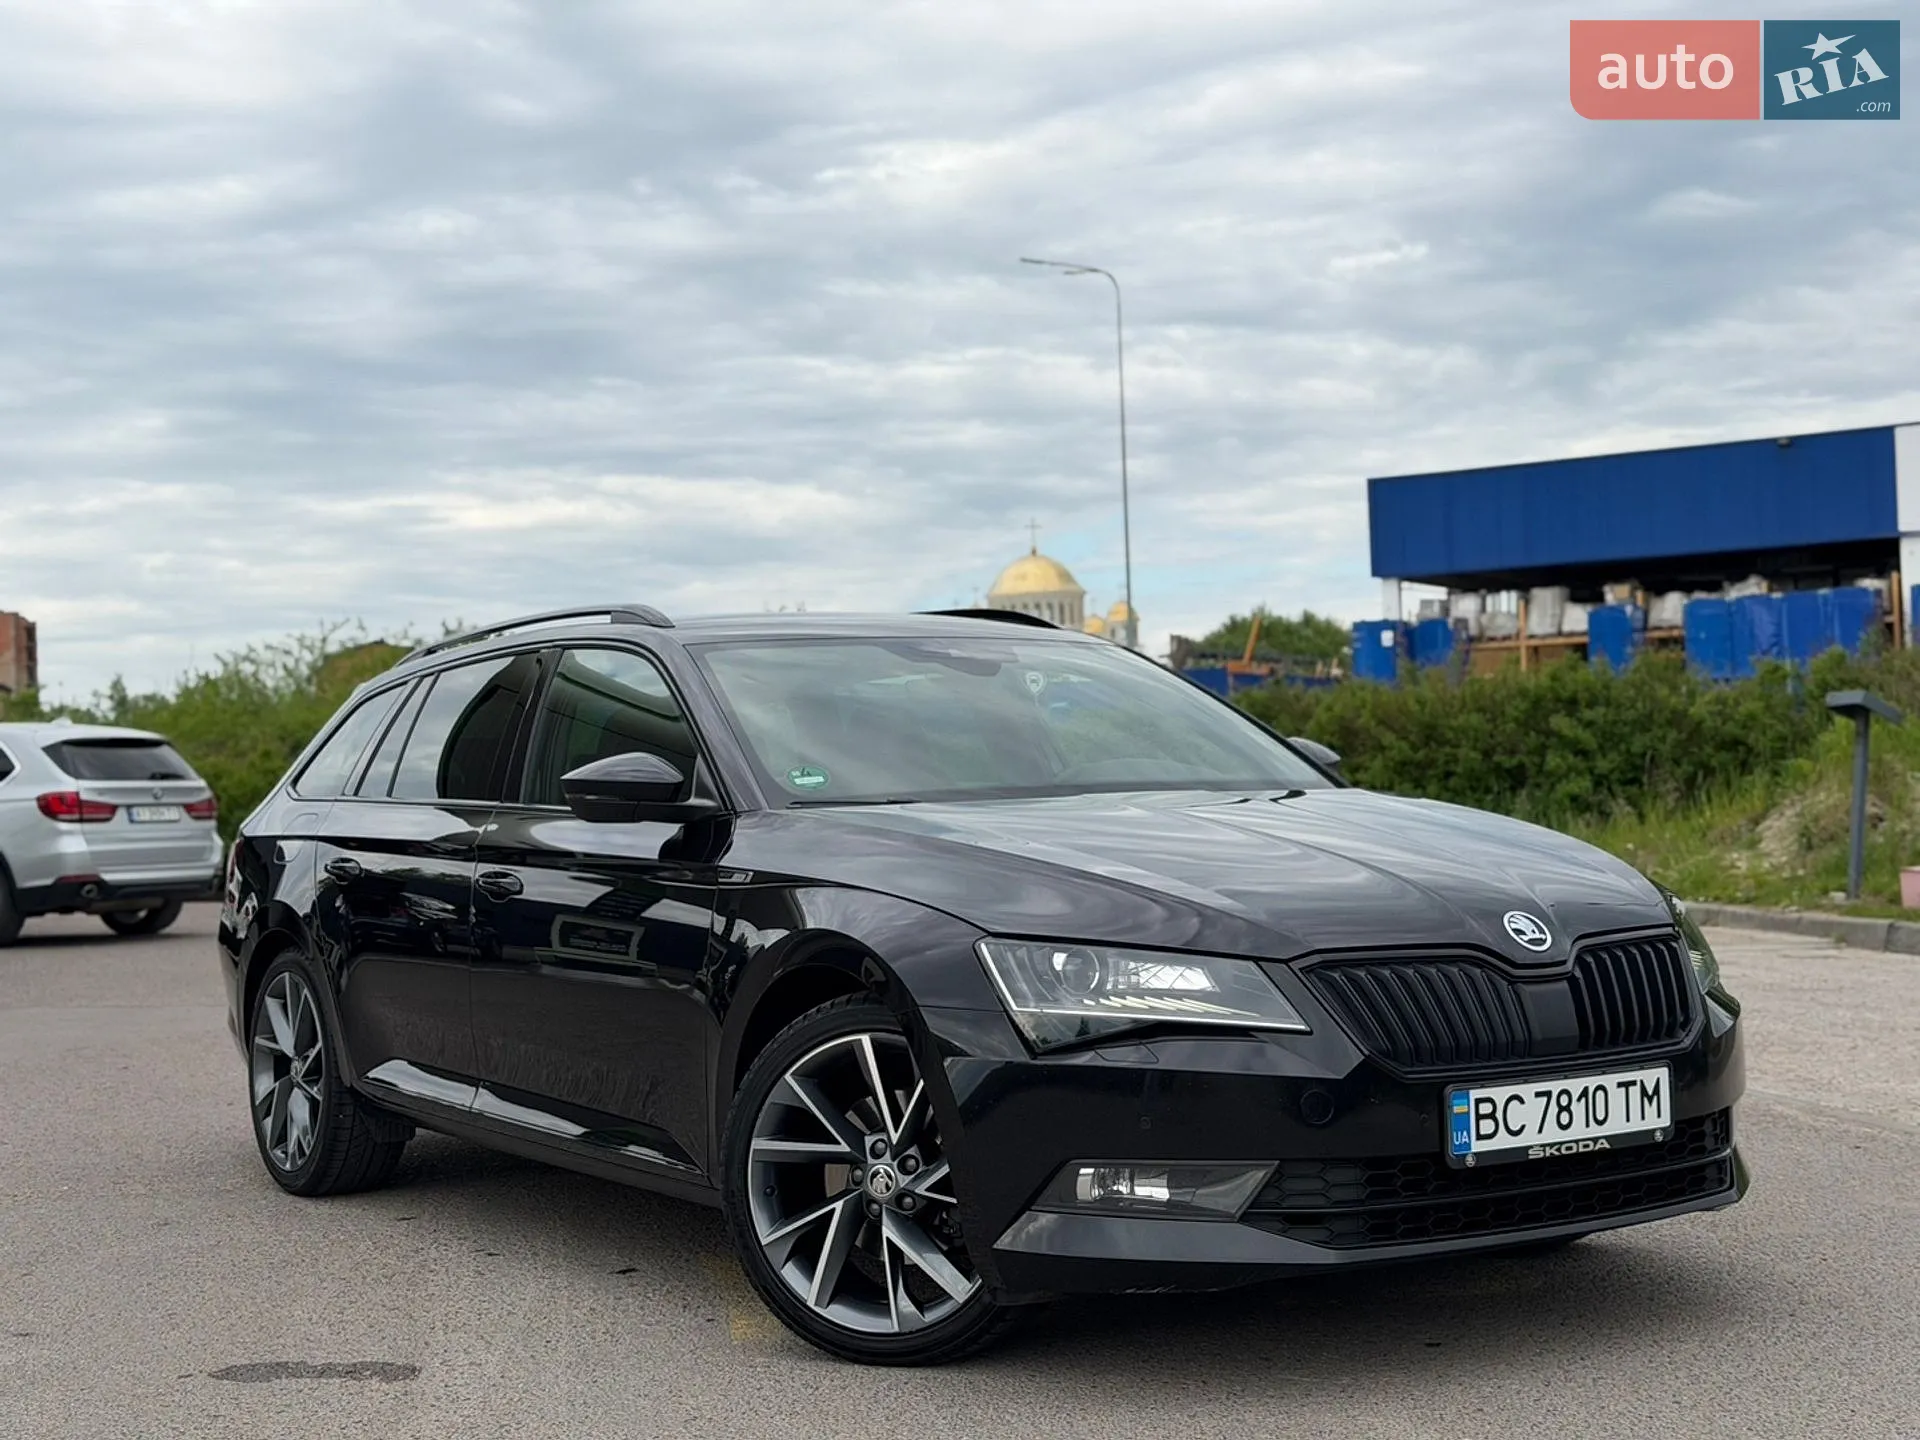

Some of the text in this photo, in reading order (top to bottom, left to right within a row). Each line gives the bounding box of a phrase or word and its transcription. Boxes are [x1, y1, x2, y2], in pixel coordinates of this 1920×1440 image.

[1474, 1077, 1662, 1141] BC 7810 TM
[1453, 1131, 1469, 1146] UA
[1528, 1138, 1611, 1160] ŠKODA
